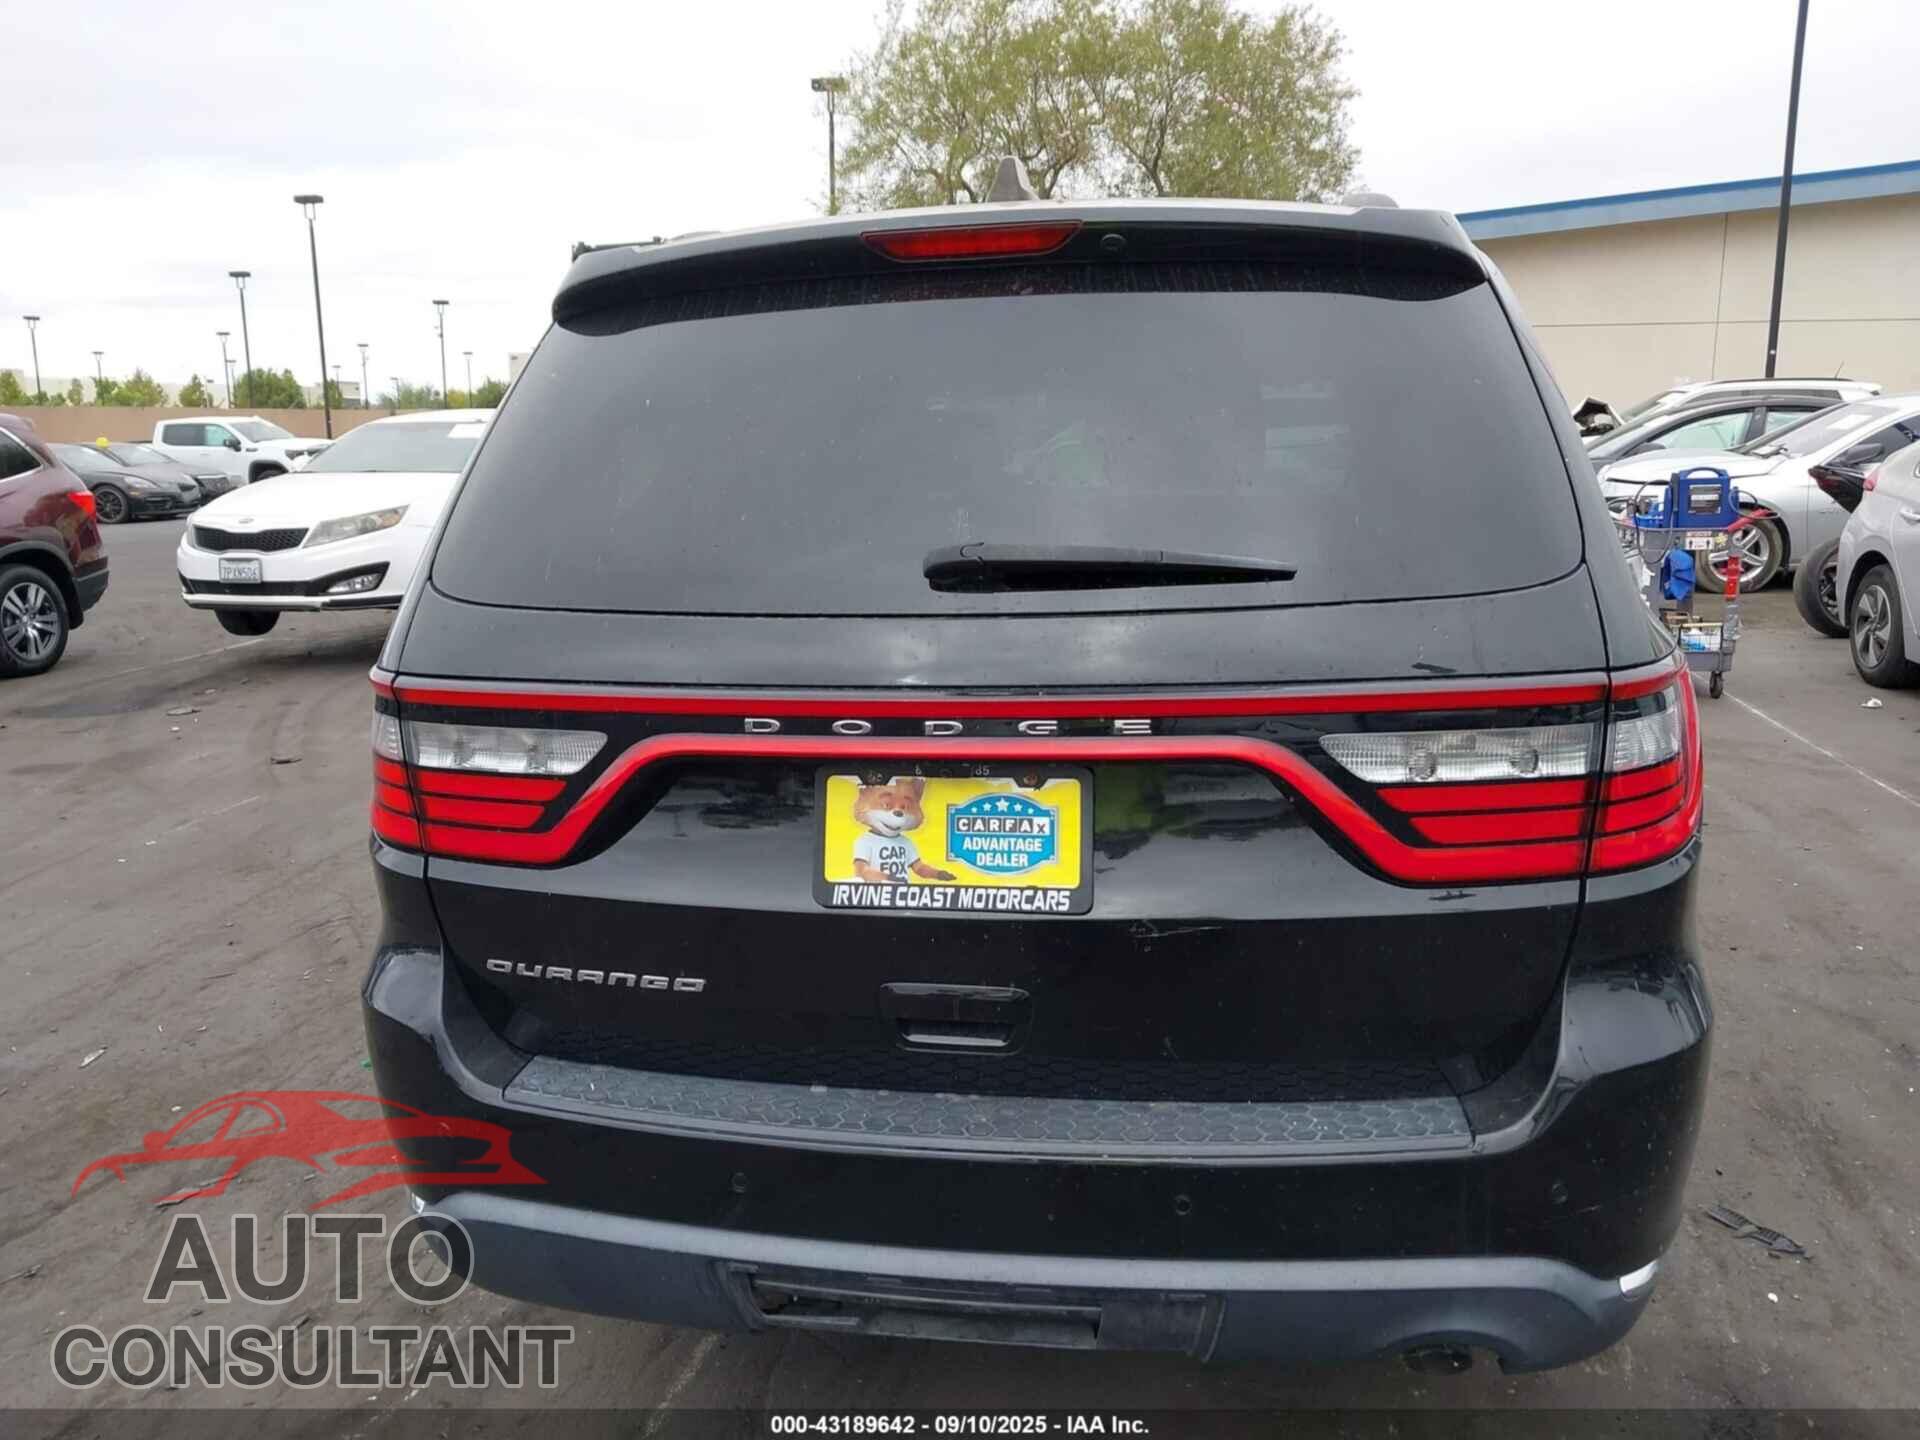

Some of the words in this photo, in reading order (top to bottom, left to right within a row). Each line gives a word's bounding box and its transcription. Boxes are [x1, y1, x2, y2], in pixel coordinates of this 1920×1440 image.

[744, 718, 1152, 735] DODGE
[957, 818, 1047, 833] CARFAX
[962, 837, 1043, 852] ADVANTAGE
[879, 846, 906, 860] CAR
[976, 852, 1028, 867] DEALER
[880, 861, 907, 875] FOX
[832, 884, 893, 906] IRVINE
[895, 886, 955, 908] COAST
[958, 887, 1071, 911] MOTORCARS
[486, 958, 706, 992] DURANGO
